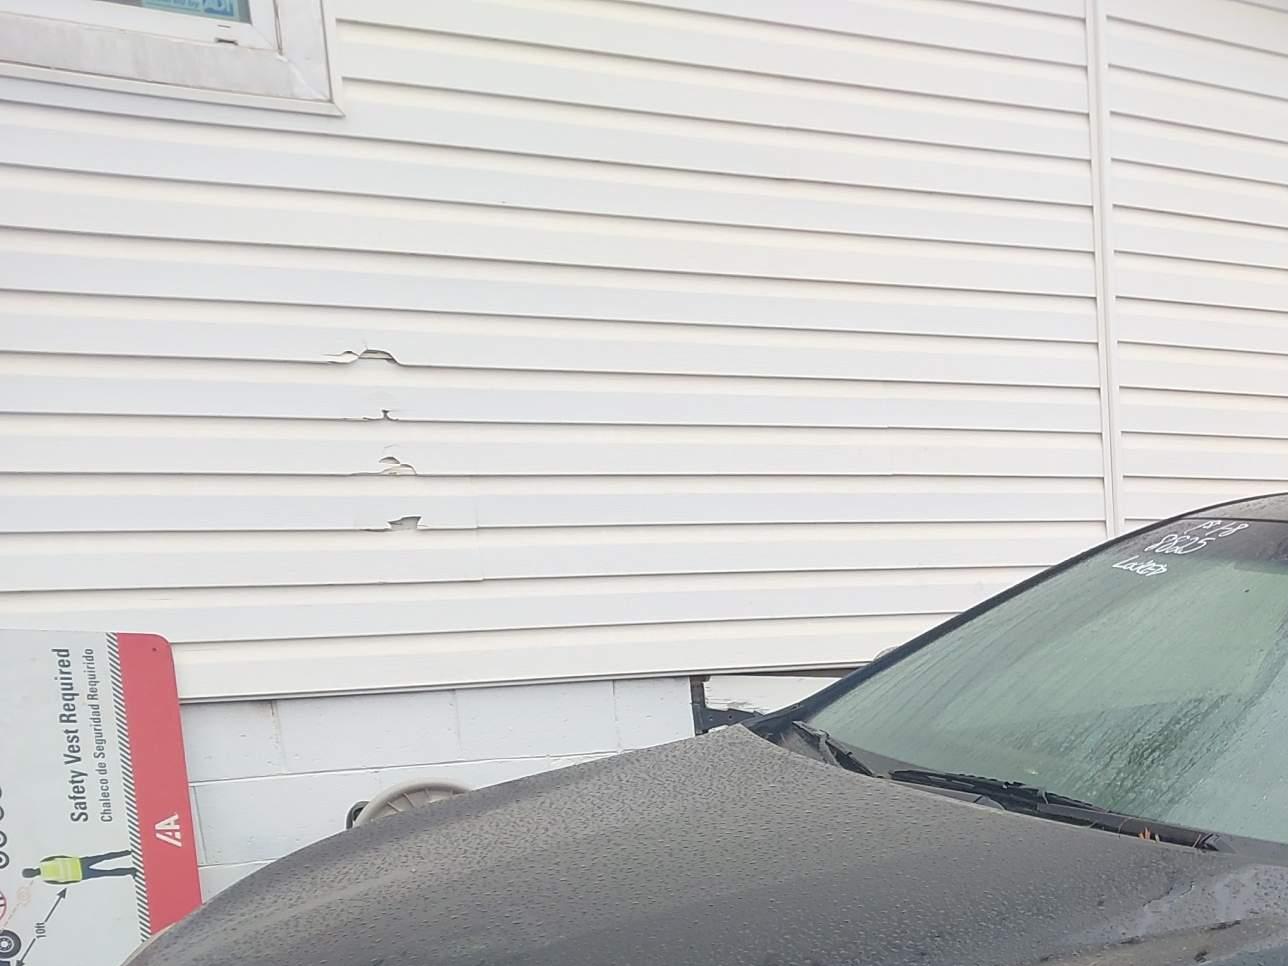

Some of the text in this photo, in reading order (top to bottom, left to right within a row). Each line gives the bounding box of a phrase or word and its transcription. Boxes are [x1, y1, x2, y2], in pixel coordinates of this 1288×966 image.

[51, 648, 89, 823] Safety Vest Required
[82, 648, 113, 823] Chaleco de Seguridad Requirido
[35, 922, 46, 939] 10ft
